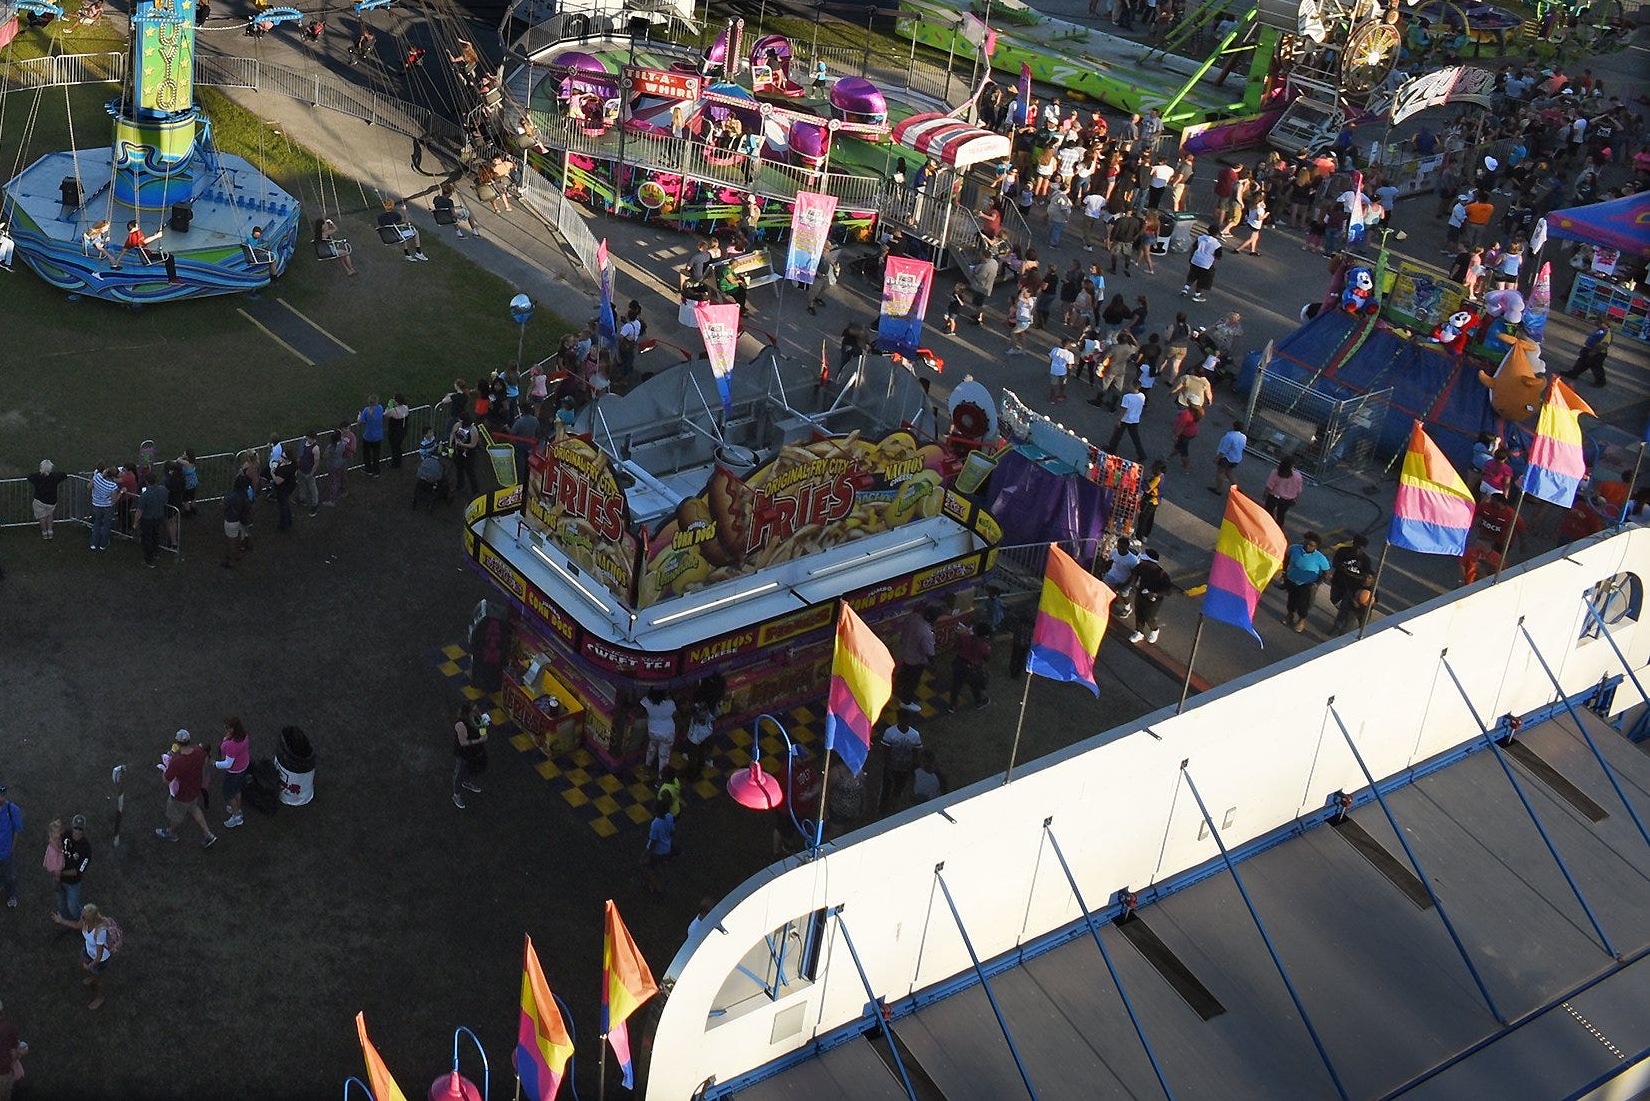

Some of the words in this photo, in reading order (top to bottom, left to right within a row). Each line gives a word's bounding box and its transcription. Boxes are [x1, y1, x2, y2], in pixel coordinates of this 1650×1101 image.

[645, 82, 694, 100] WHIRL
[764, 466, 809, 498] ORIGINAL
[809, 458, 828, 477] FRY
[828, 457, 850, 475] CITY
[884, 455, 926, 482] NACHOS
[542, 444, 625, 542] FRIES
[746, 458, 859, 554] FRIES
[672, 530, 695, 551] CORN
[695, 521, 718, 545] DOGS
[880, 582, 909, 604] DOGS
[529, 591, 550, 618] CORN
[550, 616, 573, 641] DOGS
[587, 643, 639, 667] SWEET
[643, 660, 671, 670] TEA
[690, 632, 753, 663] NACHOS
[700, 648, 738, 665] CHEESE
